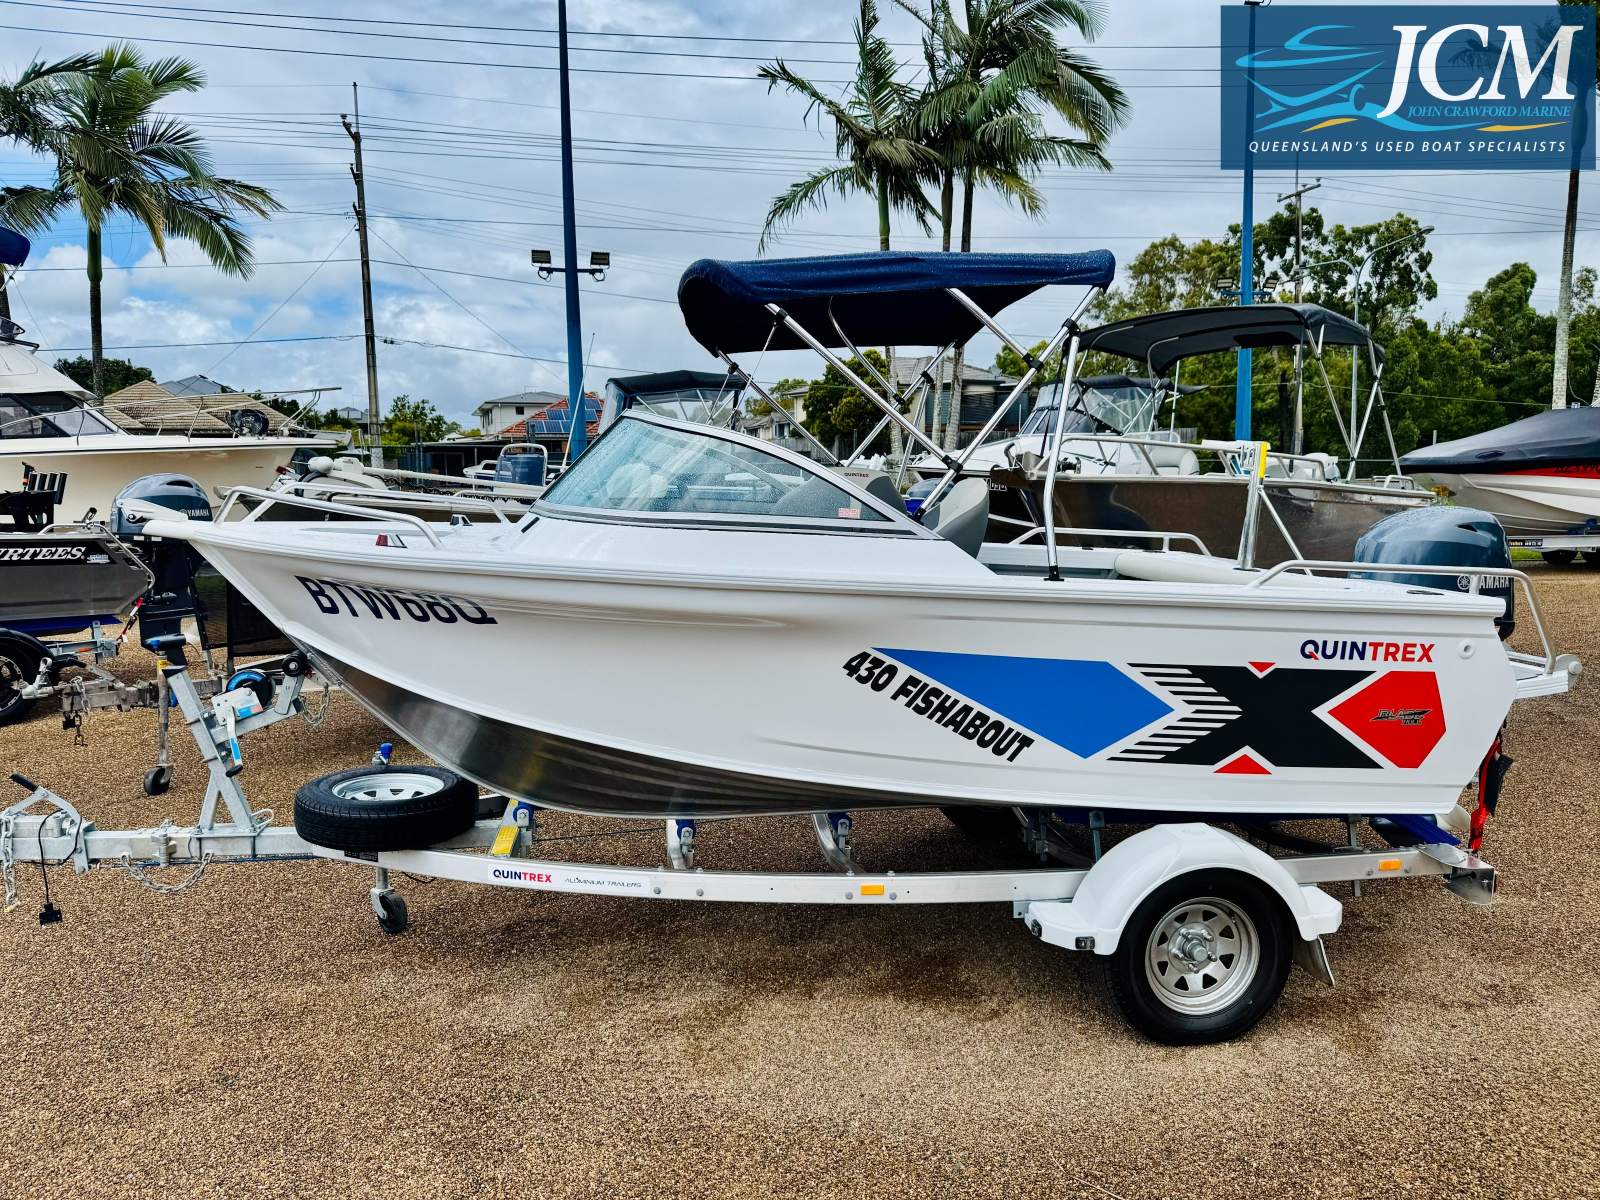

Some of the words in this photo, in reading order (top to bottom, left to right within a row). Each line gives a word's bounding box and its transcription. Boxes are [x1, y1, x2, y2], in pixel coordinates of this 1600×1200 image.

[187, 509, 210, 517] YAMAHA
[1479, 576, 1510, 588] AMAHA
[1300, 639, 1435, 662] QUINTREX
[842, 651, 898, 692] 430
[890, 675, 1035, 762] FISHABOUT
[493, 869, 552, 883] QUINTREX
[565, 876, 605, 886] ALUMINIUM
[607, 880, 642, 888] TRAILERS
